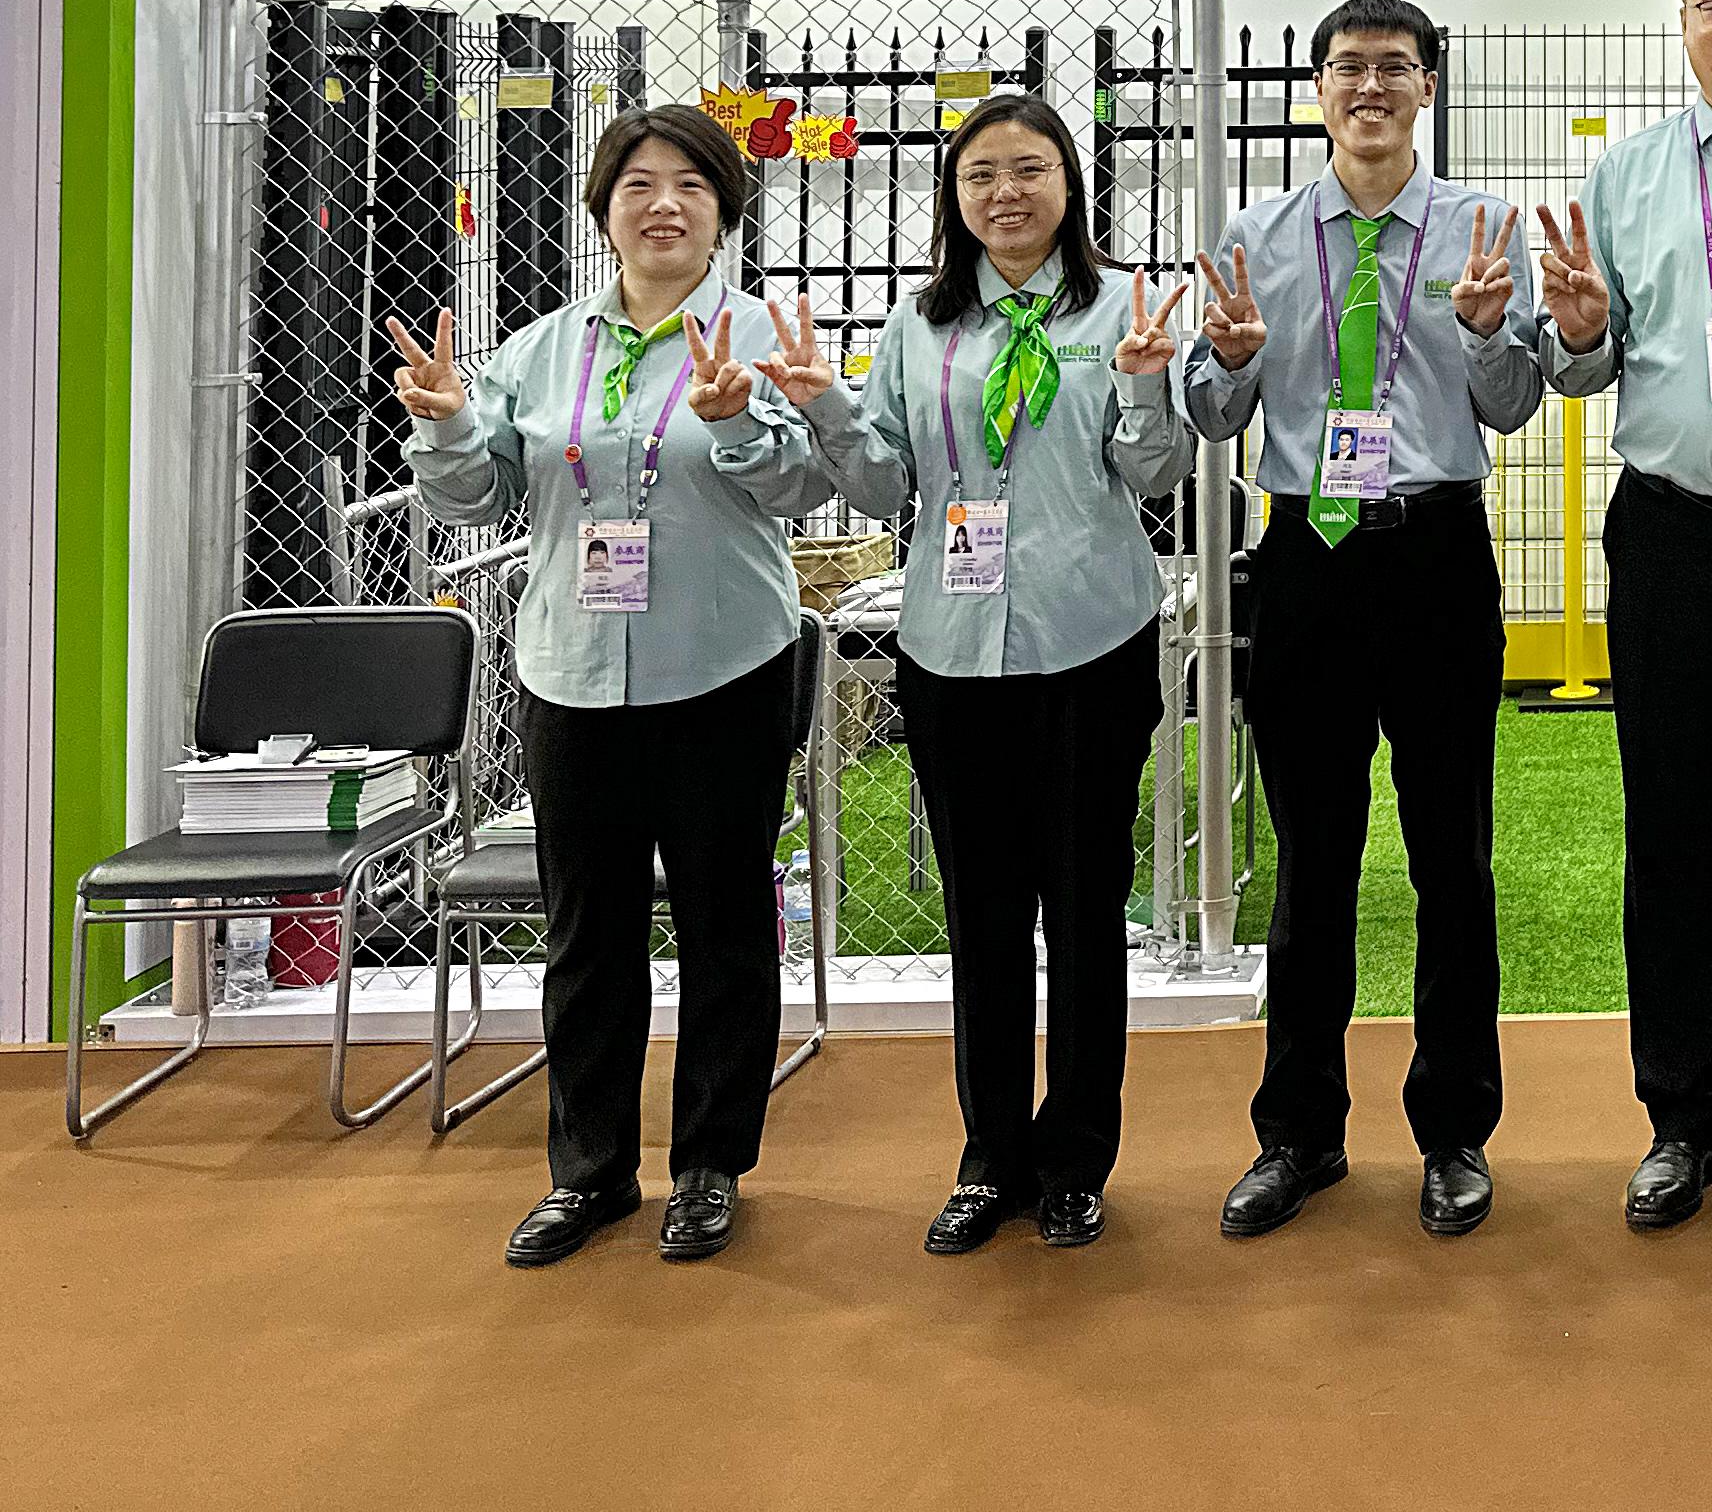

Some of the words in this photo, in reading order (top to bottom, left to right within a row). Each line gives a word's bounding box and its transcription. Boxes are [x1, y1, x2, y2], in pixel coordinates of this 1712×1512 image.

[706, 100, 743, 120] Best
[800, 124, 822, 139] Hot
[801, 138, 829, 153] Sale
